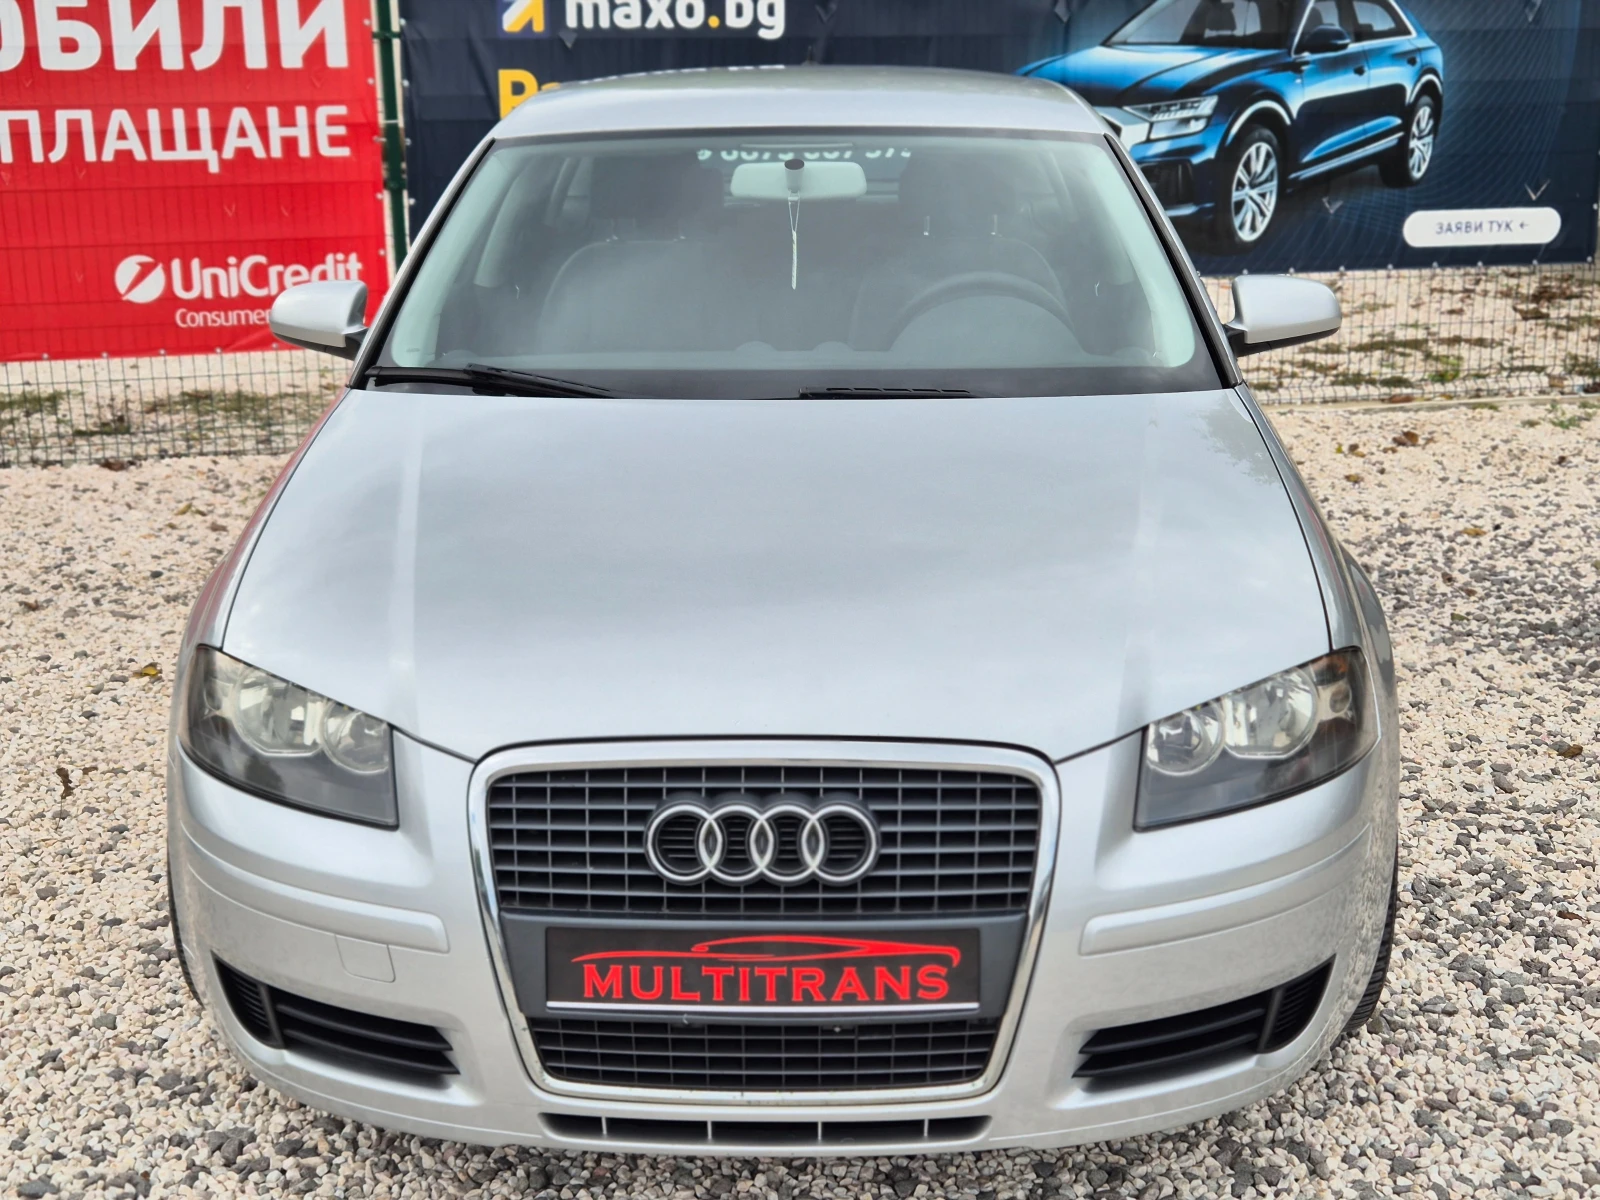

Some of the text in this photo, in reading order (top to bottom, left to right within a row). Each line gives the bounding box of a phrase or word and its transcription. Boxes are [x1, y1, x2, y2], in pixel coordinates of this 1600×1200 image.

[565, 0, 786, 40] maxo.bg
[1435, 220, 1514, 235] ЗАЯВИ ТУК
[582, 963, 951, 1002] MULTITRANS
